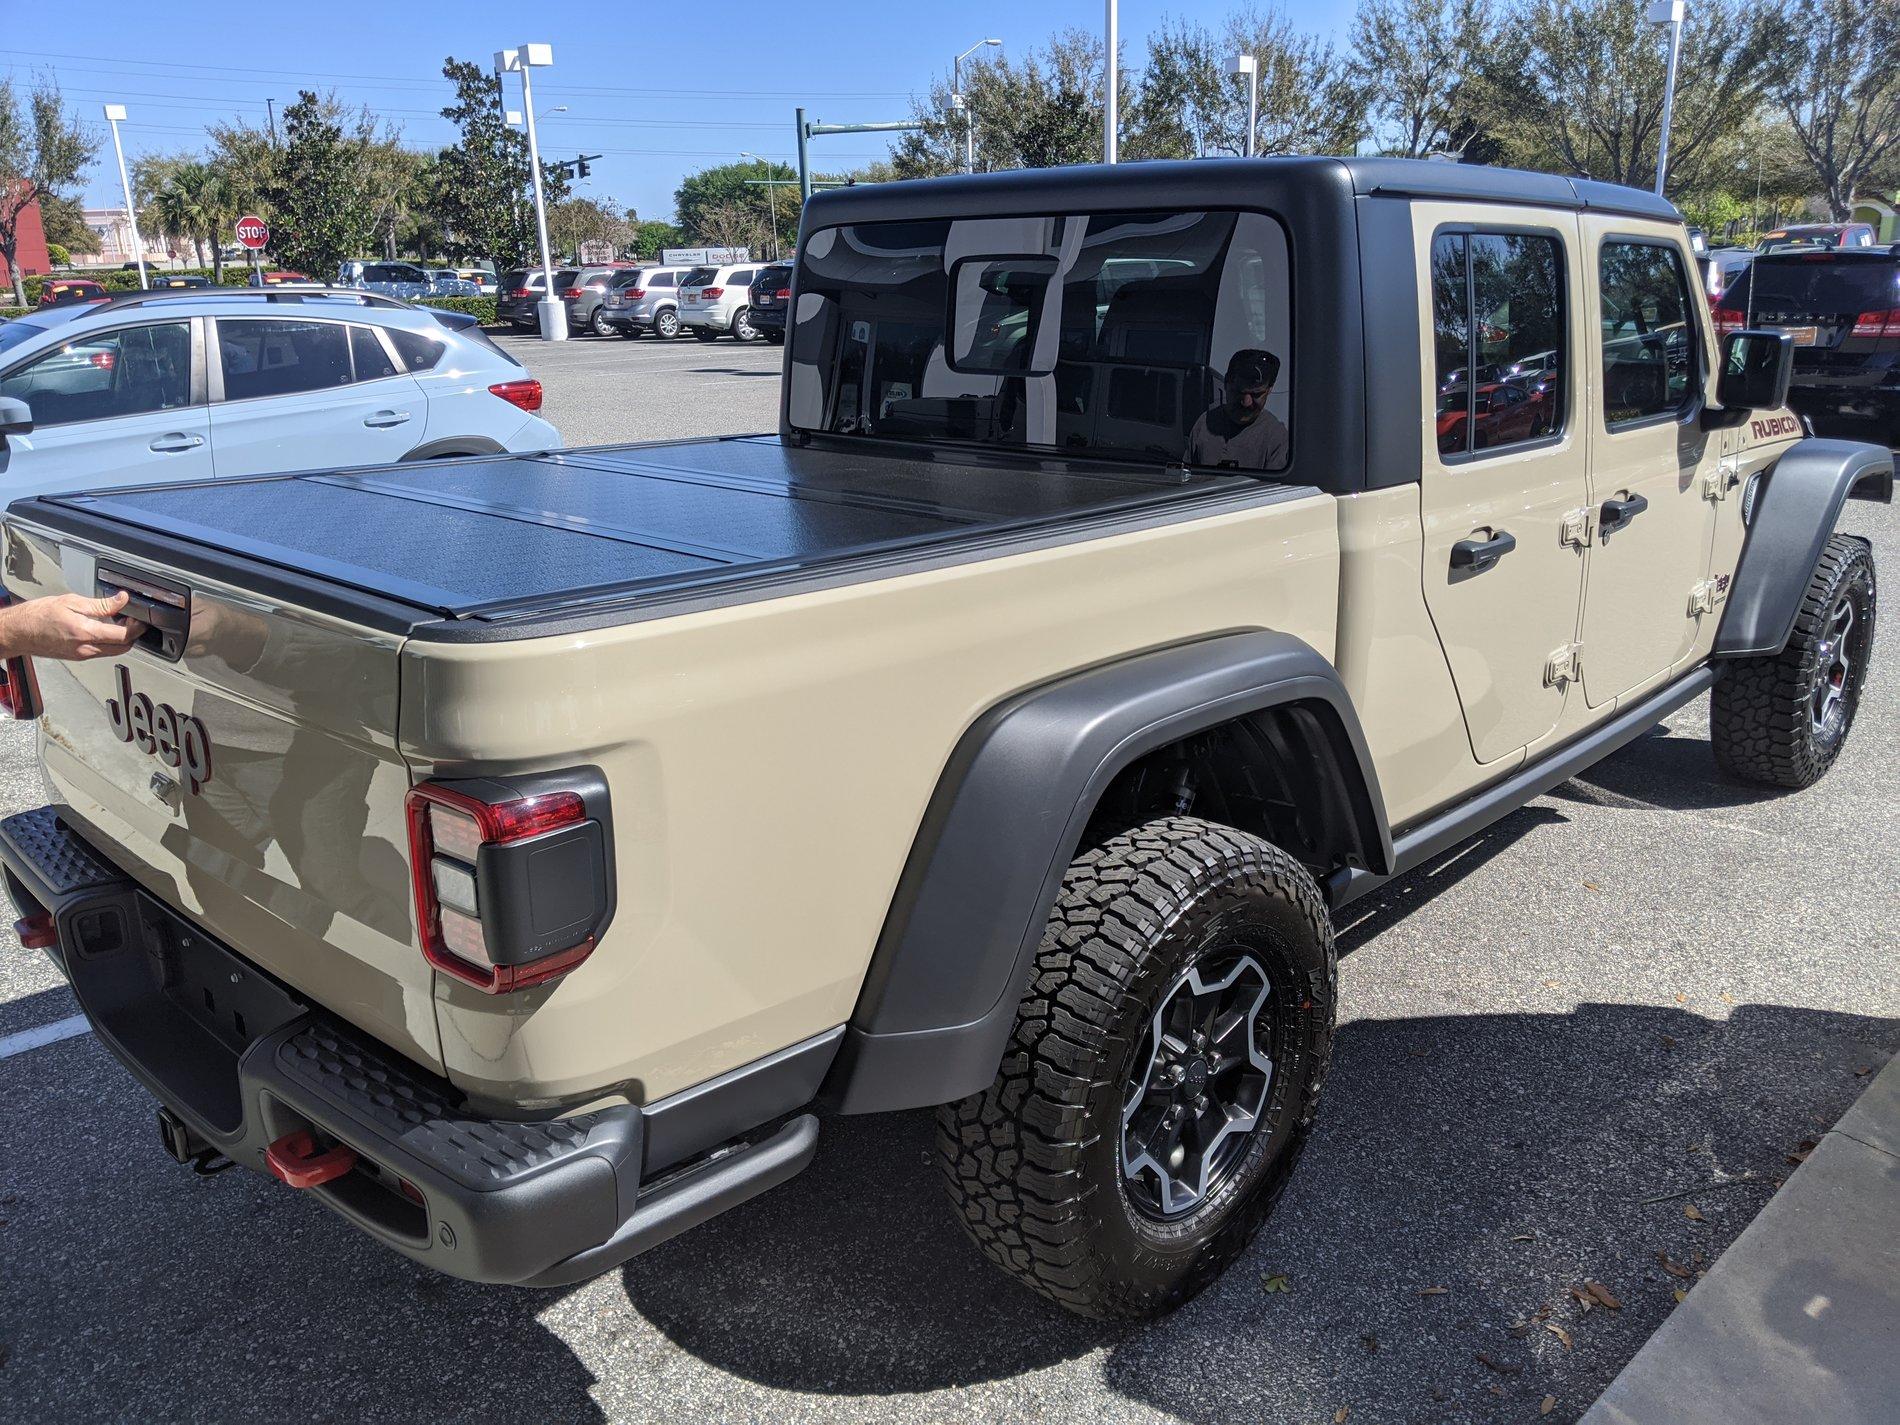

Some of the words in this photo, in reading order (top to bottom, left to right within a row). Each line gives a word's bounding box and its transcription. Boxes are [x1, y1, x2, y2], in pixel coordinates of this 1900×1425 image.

[239, 226, 266, 239] STOP
[1750, 416, 1801, 440] RUBICON
[105, 663, 213, 797] Jeep
